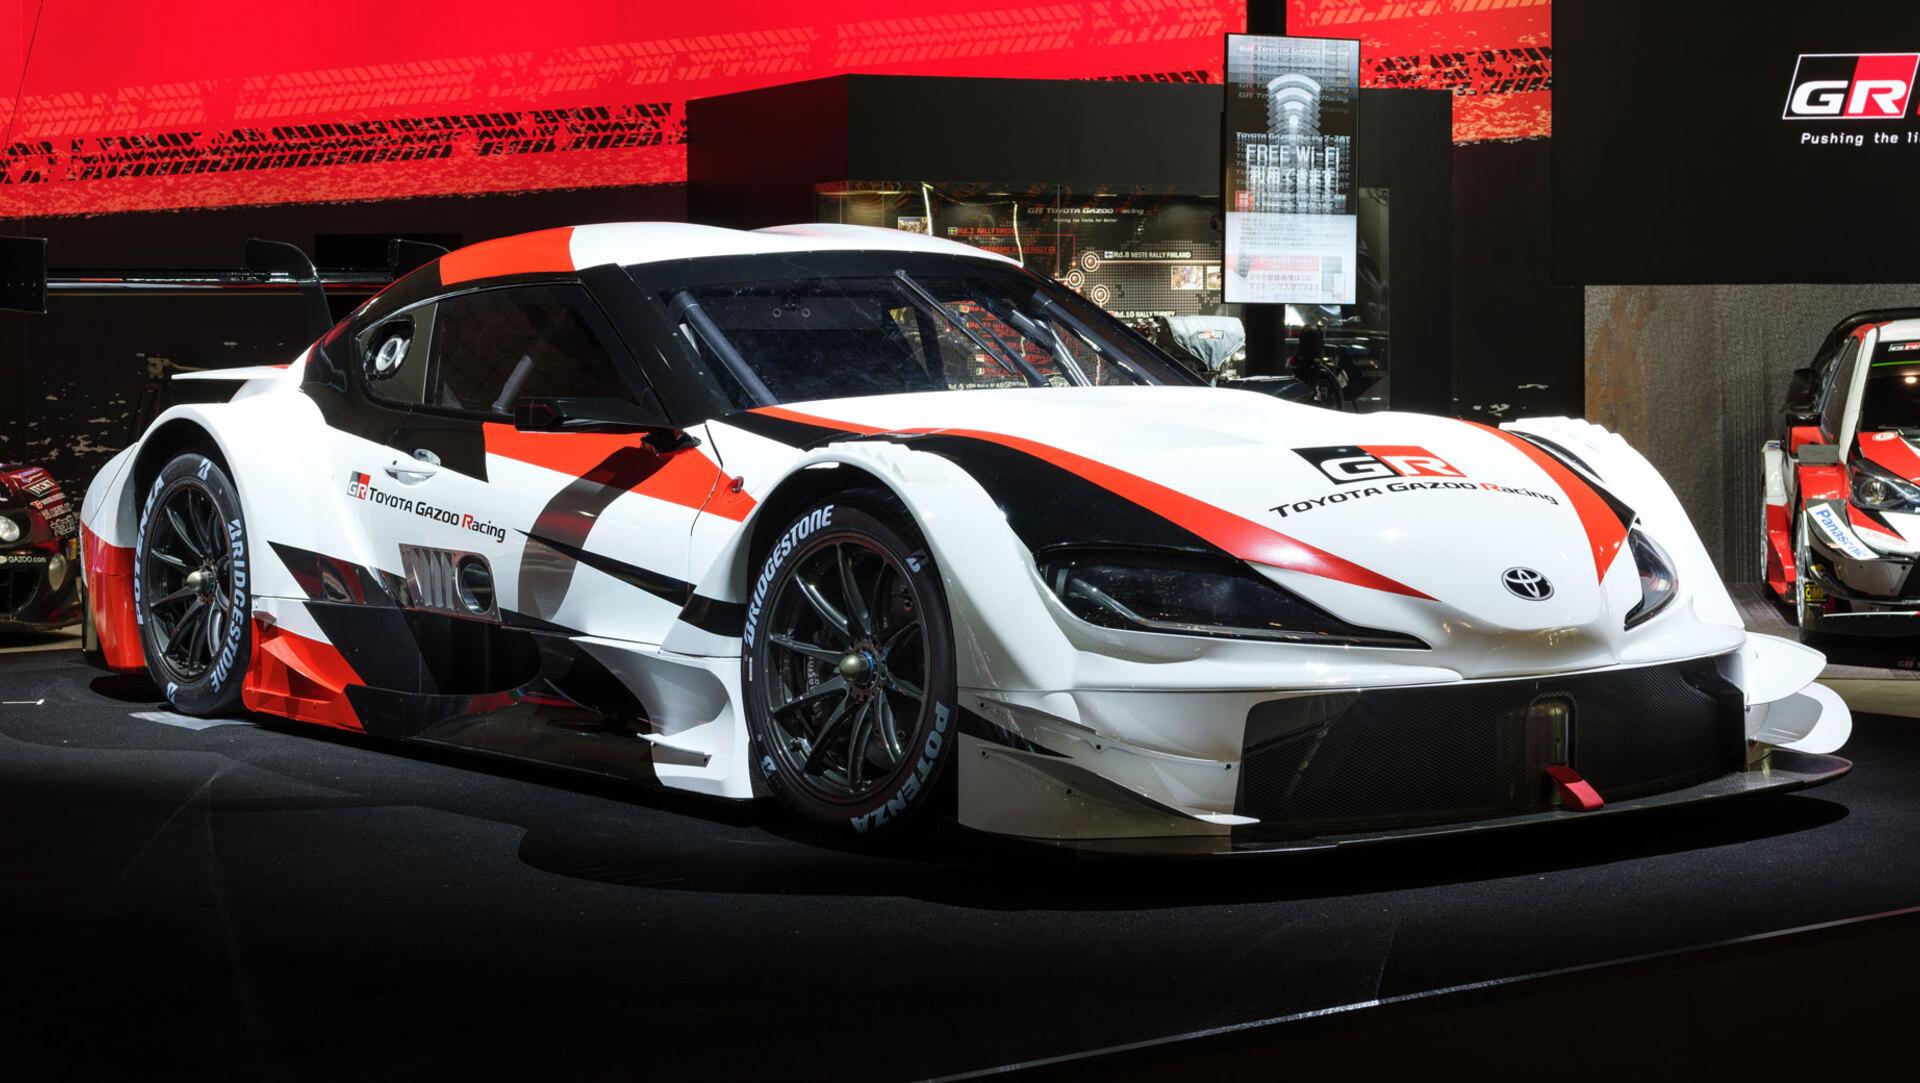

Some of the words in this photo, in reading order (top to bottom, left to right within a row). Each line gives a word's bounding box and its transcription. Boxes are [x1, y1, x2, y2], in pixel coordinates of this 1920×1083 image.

[1791, 80, 1907, 114] GR
[1246, 144, 1290, 163] FREE
[1801, 132, 1864, 146] Pushing
[1874, 132, 1898, 144] the
[1907, 132, 1920, 144] li
[1114, 310, 1134, 318] Rd.10
[1320, 455, 1461, 481] GR
[348, 481, 369, 500] GR
[1269, 487, 1382, 518] TOYOTA
[1386, 482, 1477, 493] GAZOO
[1480, 482, 1559, 505] Racing
[369, 487, 413, 513] TOYOTA
[415, 501, 460, 526] GAZOO
[461, 513, 506, 543] Racing
[134, 475, 165, 625] POTENZA
[743, 504, 834, 648] BRIDGESTONE
[210, 519, 246, 694] BRIDGESTONE
[851, 701, 950, 835] POTENZA
